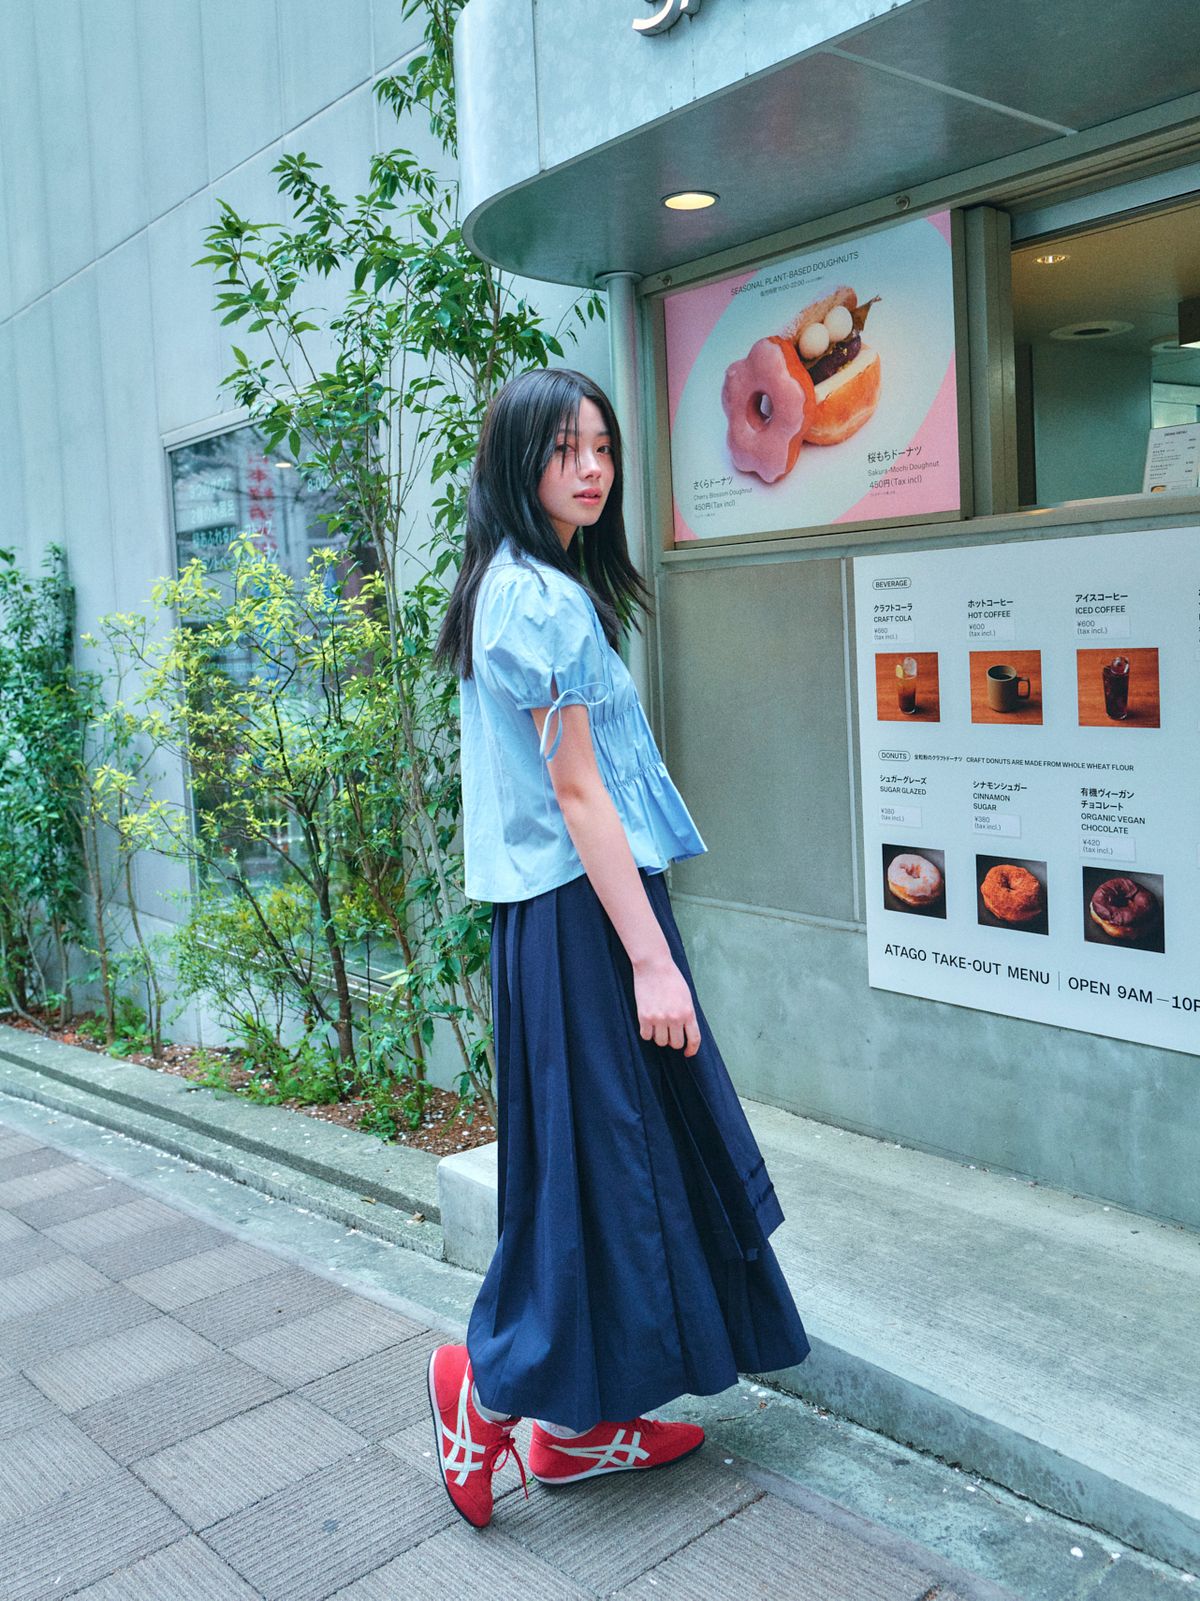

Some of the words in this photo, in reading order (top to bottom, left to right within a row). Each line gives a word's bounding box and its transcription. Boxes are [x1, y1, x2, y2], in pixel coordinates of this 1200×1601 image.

[730, 280, 764, 296] SEASONAL
[765, 265, 812, 286] PLANT-BASED
[812, 251, 859, 274] DOUGHNUTS
[867, 446, 922, 464] 桜もちドーナツ
[909, 460, 940, 471] Doughnut
[693, 476, 733, 490] さくらドーナツ
[875, 580, 908, 588] BEVERAGE
[968, 598, 1014, 608] ホットコーヒー
[1075, 592, 1128, 603] アイスコーヒー
[873, 603, 913, 613] クラフトコーラ
[1075, 606, 1094, 614] ICED
[1094, 605, 1126, 614] COFFEE
[983, 610, 1011, 618] COFFEE
[986, 757, 1011, 765] DONUTS
[1043, 760, 1061, 768] FROM
[1061, 761, 1086, 769] WHOLE
[880, 774, 927, 785] シュガーグレーズ
[901, 787, 927, 795] GLAZED
[973, 781, 1028, 791] シナモンシュガー
[972, 793, 1011, 802] CINNAMON
[1080, 788, 1135, 799] 有機ヴィーガン
[973, 802, 997, 811] SUGAR
[1080, 800, 1124, 811] チョコレート
[1080, 813, 1116, 822] ORGANIC
[1117, 815, 1146, 825] VEGAN
[1081, 823, 1129, 835] CHOCOLATE
[884, 943, 927, 962] ATAGO
[931, 951, 1002, 976] TAKE-OUT
[1007, 965, 1050, 985] MENU
[1068, 976, 1110, 996] OPEN
